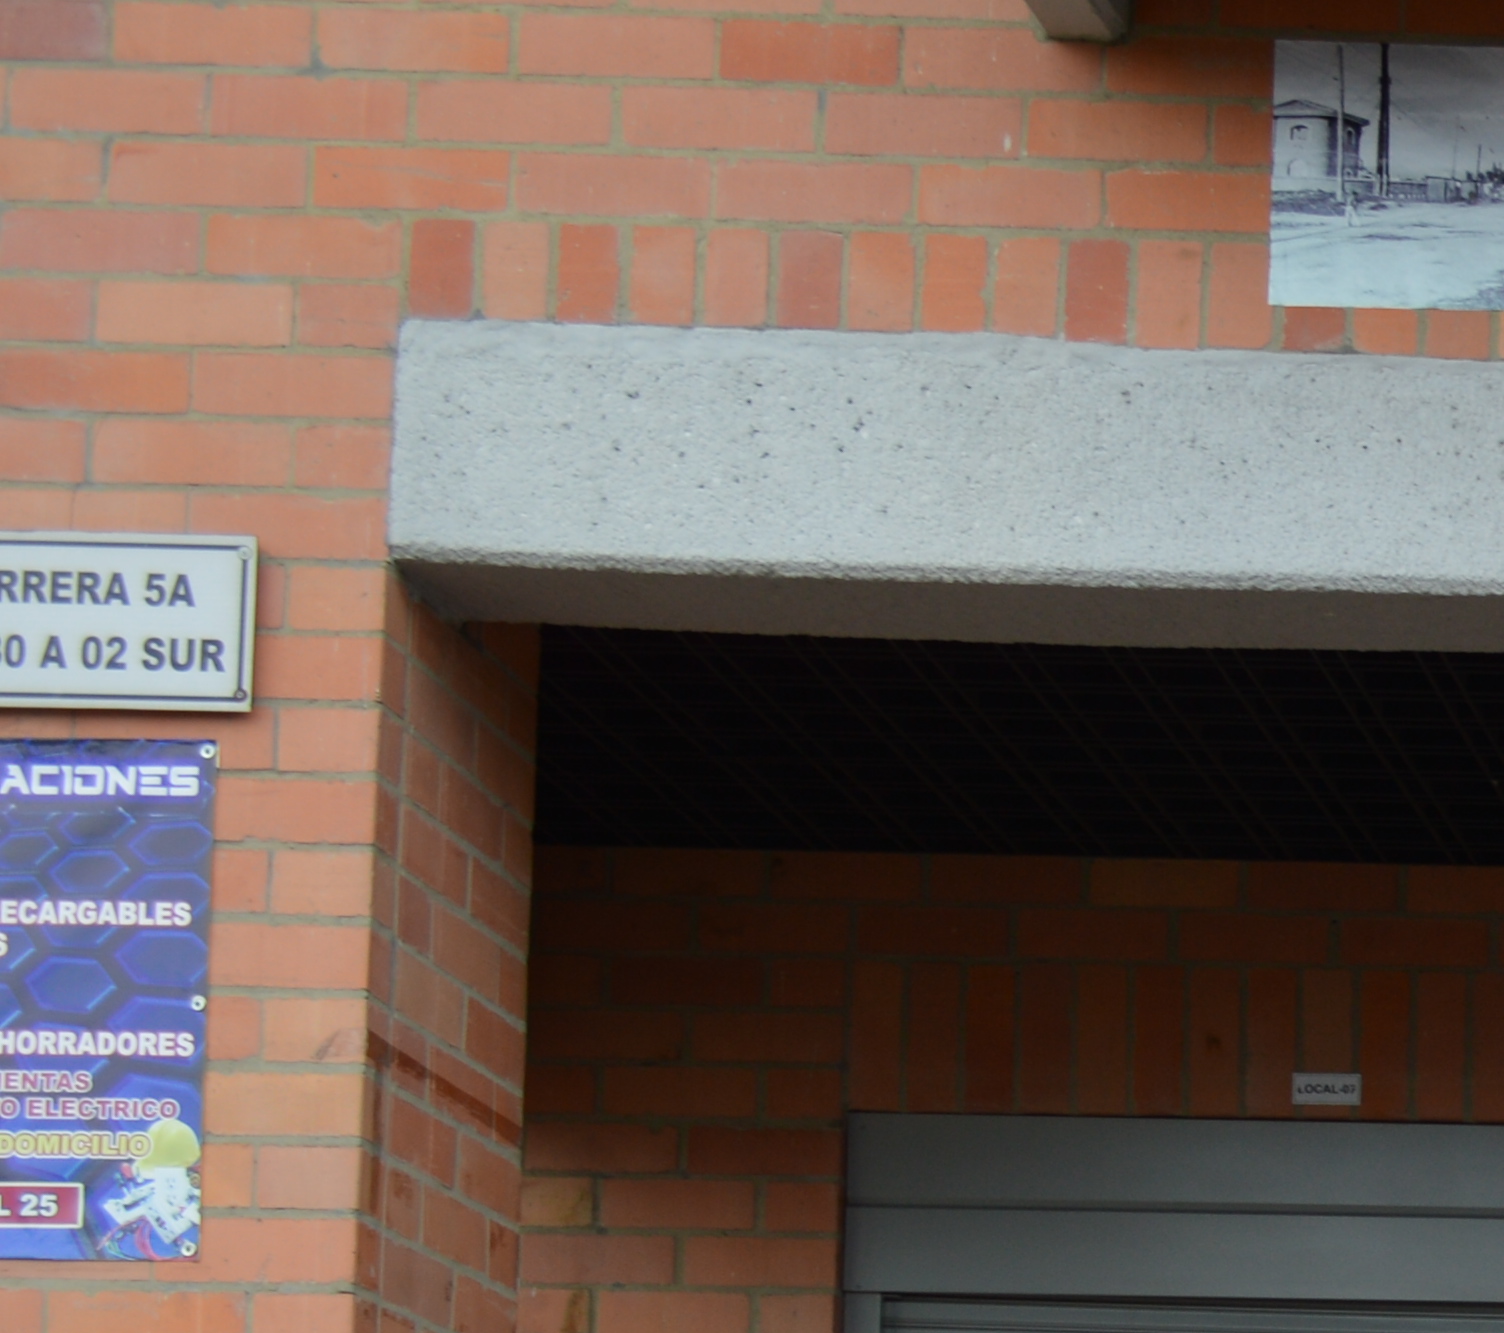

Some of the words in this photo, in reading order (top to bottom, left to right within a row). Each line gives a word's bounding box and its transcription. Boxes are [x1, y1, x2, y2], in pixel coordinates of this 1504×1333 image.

[144, 573, 196, 608] 5A
[40, 637, 67, 670] A
[80, 636, 127, 672] 02
[141, 637, 226, 674] SUR
[26, 1097, 180, 1121] ELECTRICO
[20, 1193, 59, 1217] 25
